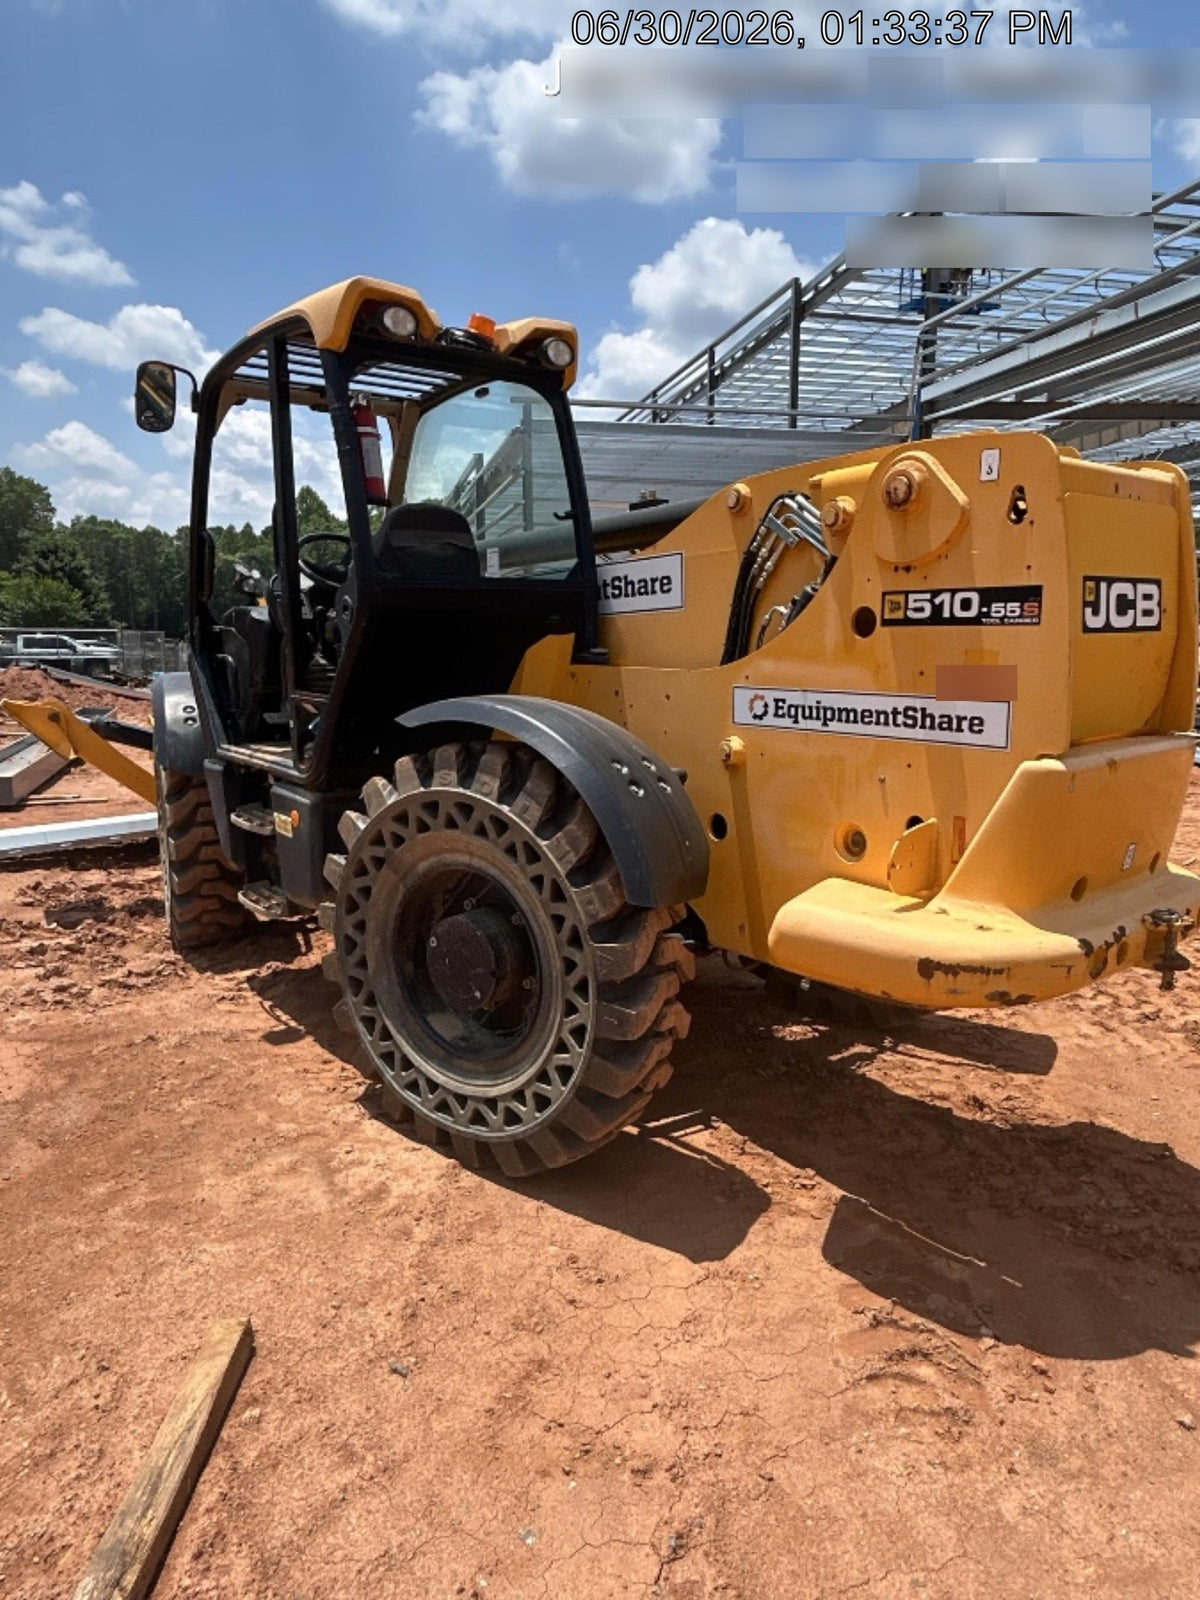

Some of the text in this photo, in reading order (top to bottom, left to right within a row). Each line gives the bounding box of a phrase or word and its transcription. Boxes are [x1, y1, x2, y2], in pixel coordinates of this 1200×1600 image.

[602, 574, 673, 600] tShare
[1084, 581, 1160, 628] JCB
[773, 698, 984, 735] EquipmentShare
